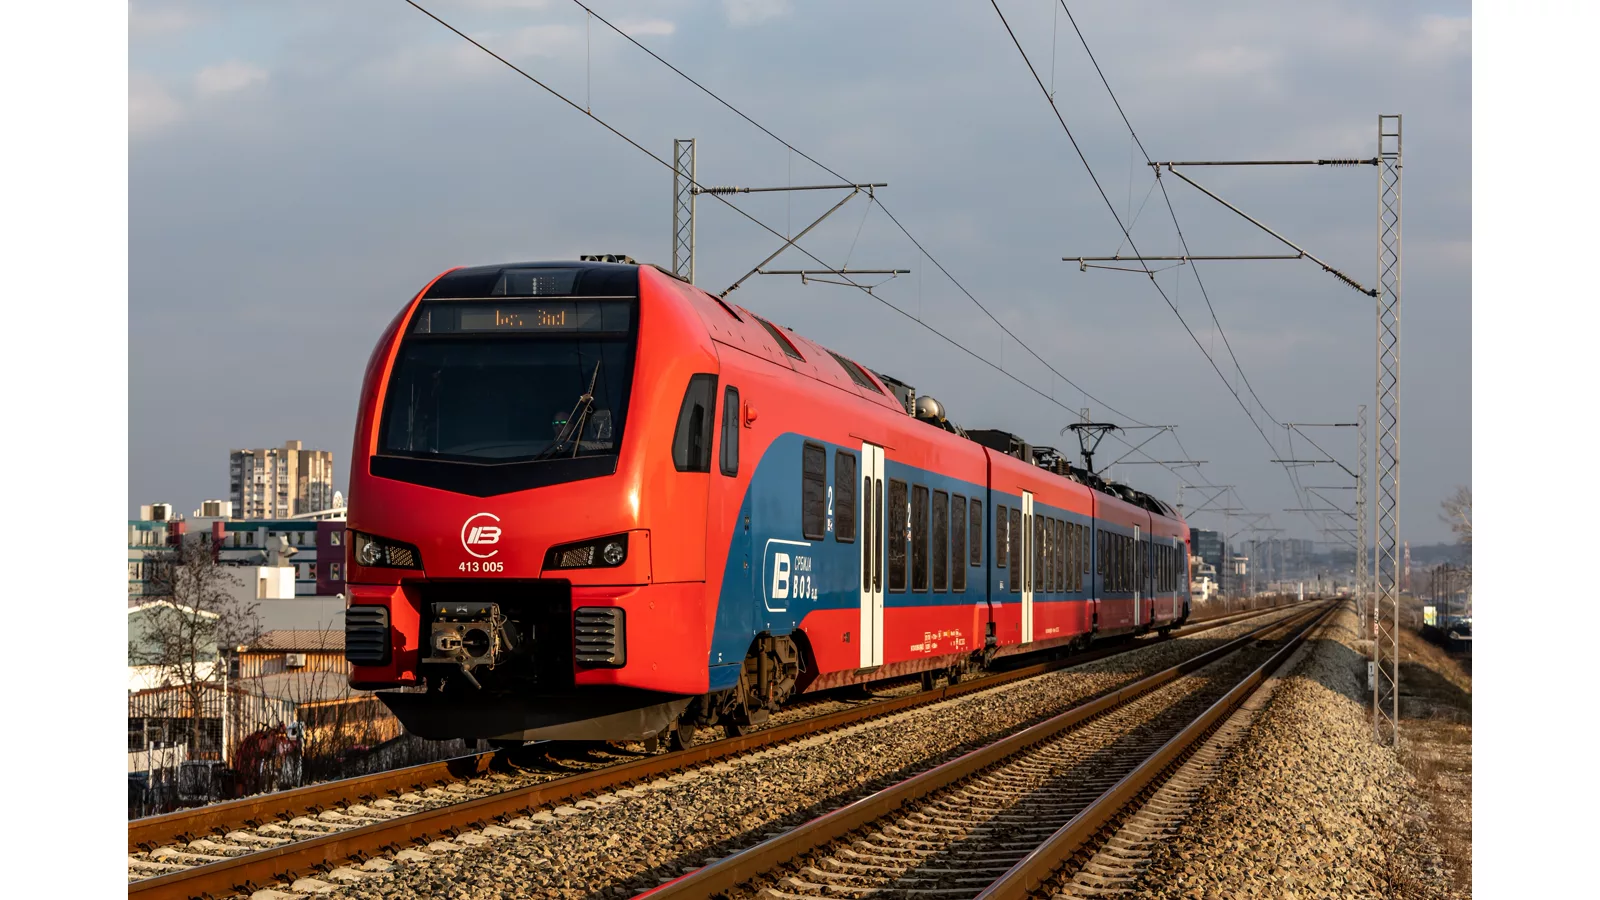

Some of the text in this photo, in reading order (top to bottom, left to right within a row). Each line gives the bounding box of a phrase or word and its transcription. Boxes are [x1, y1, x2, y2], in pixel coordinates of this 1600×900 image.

[827, 485, 833, 516] 2
[458, 561, 504, 572] 413 005
